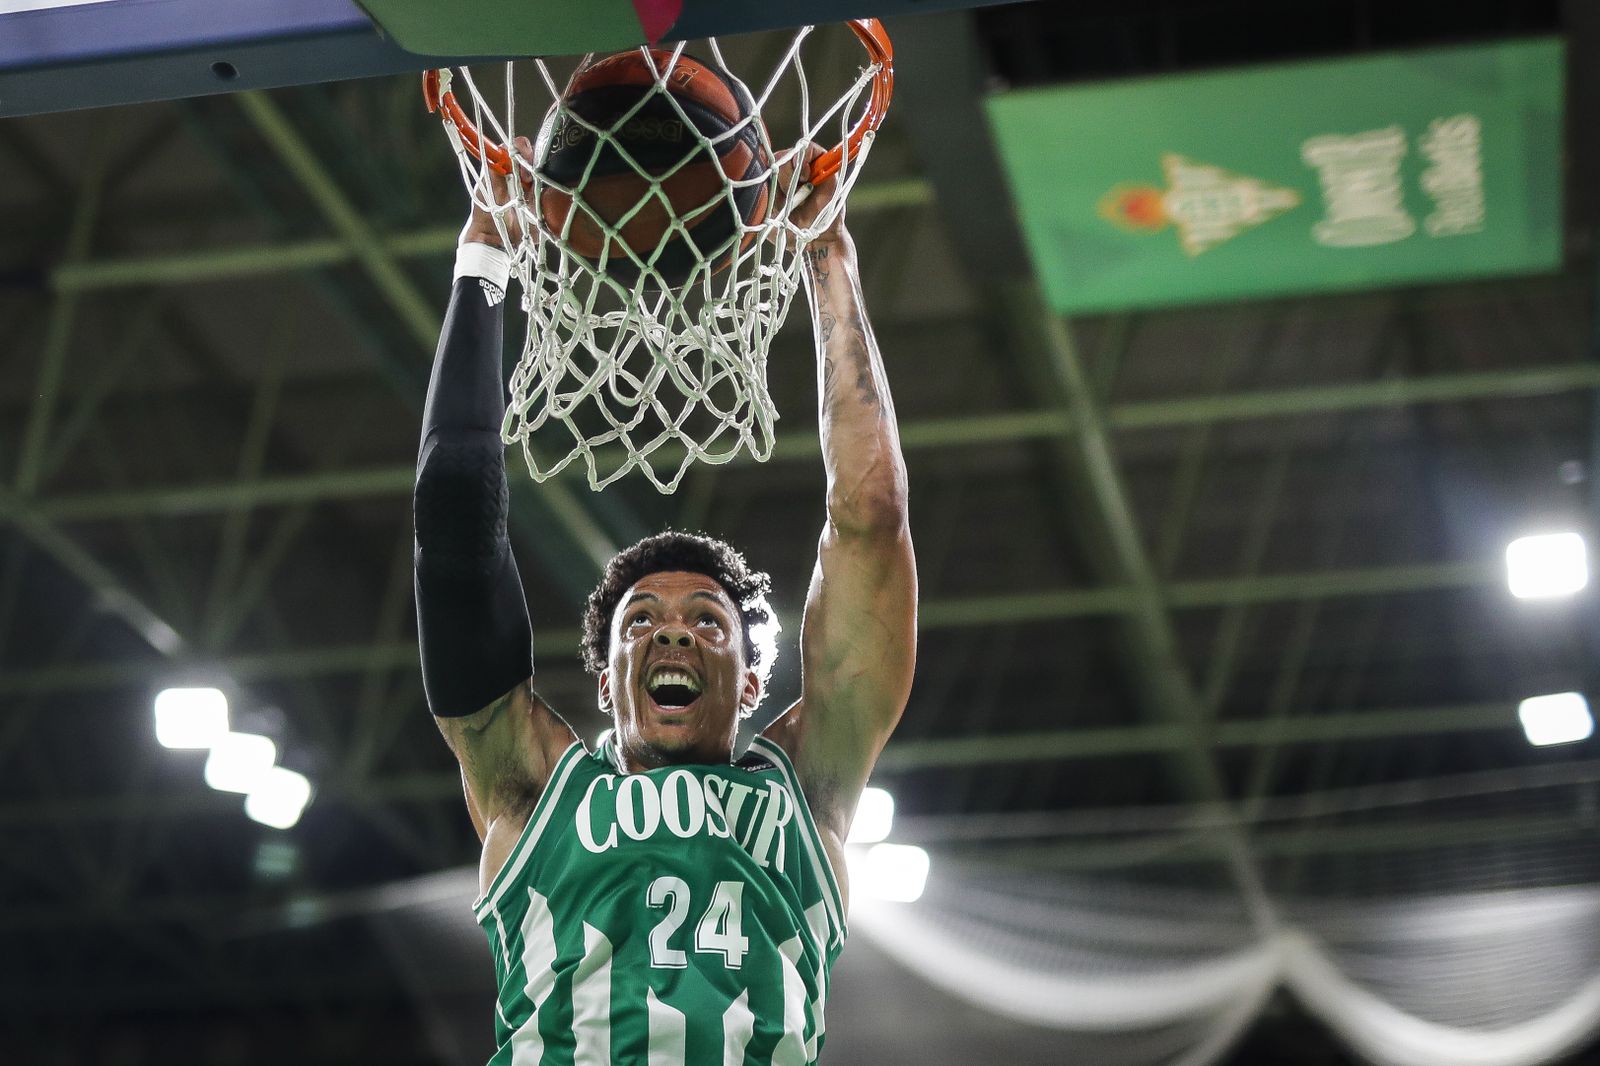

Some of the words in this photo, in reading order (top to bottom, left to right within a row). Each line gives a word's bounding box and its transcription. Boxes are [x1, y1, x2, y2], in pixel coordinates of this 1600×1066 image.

[565, 117, 683, 147] eesa
[575, 769, 793, 873] COOSUR
[646, 875, 749, 969] 24
